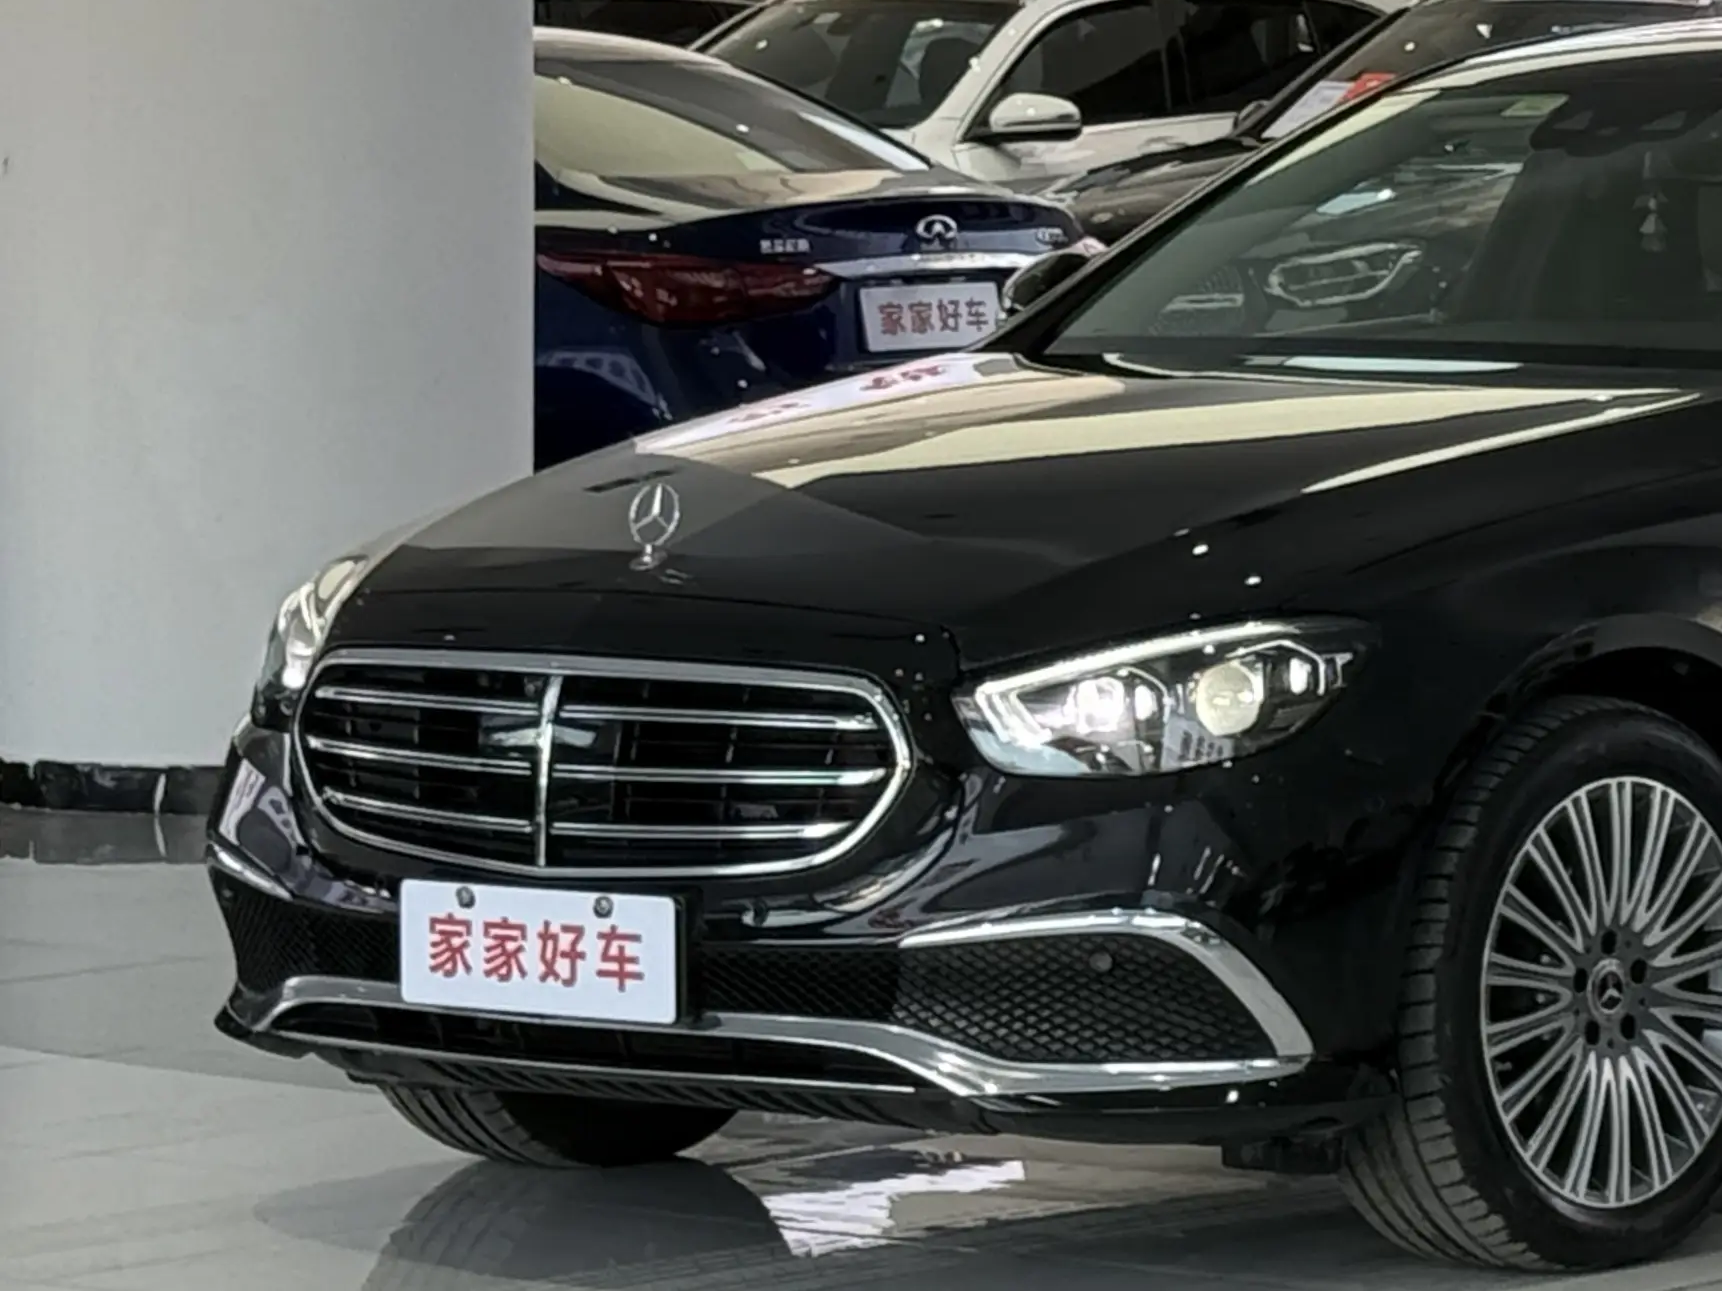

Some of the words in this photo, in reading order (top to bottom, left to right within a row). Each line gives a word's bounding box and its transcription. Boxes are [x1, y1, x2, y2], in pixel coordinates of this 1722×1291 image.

[877, 298, 989, 336] 家家好车
[428, 912, 645, 993] 家家好车
